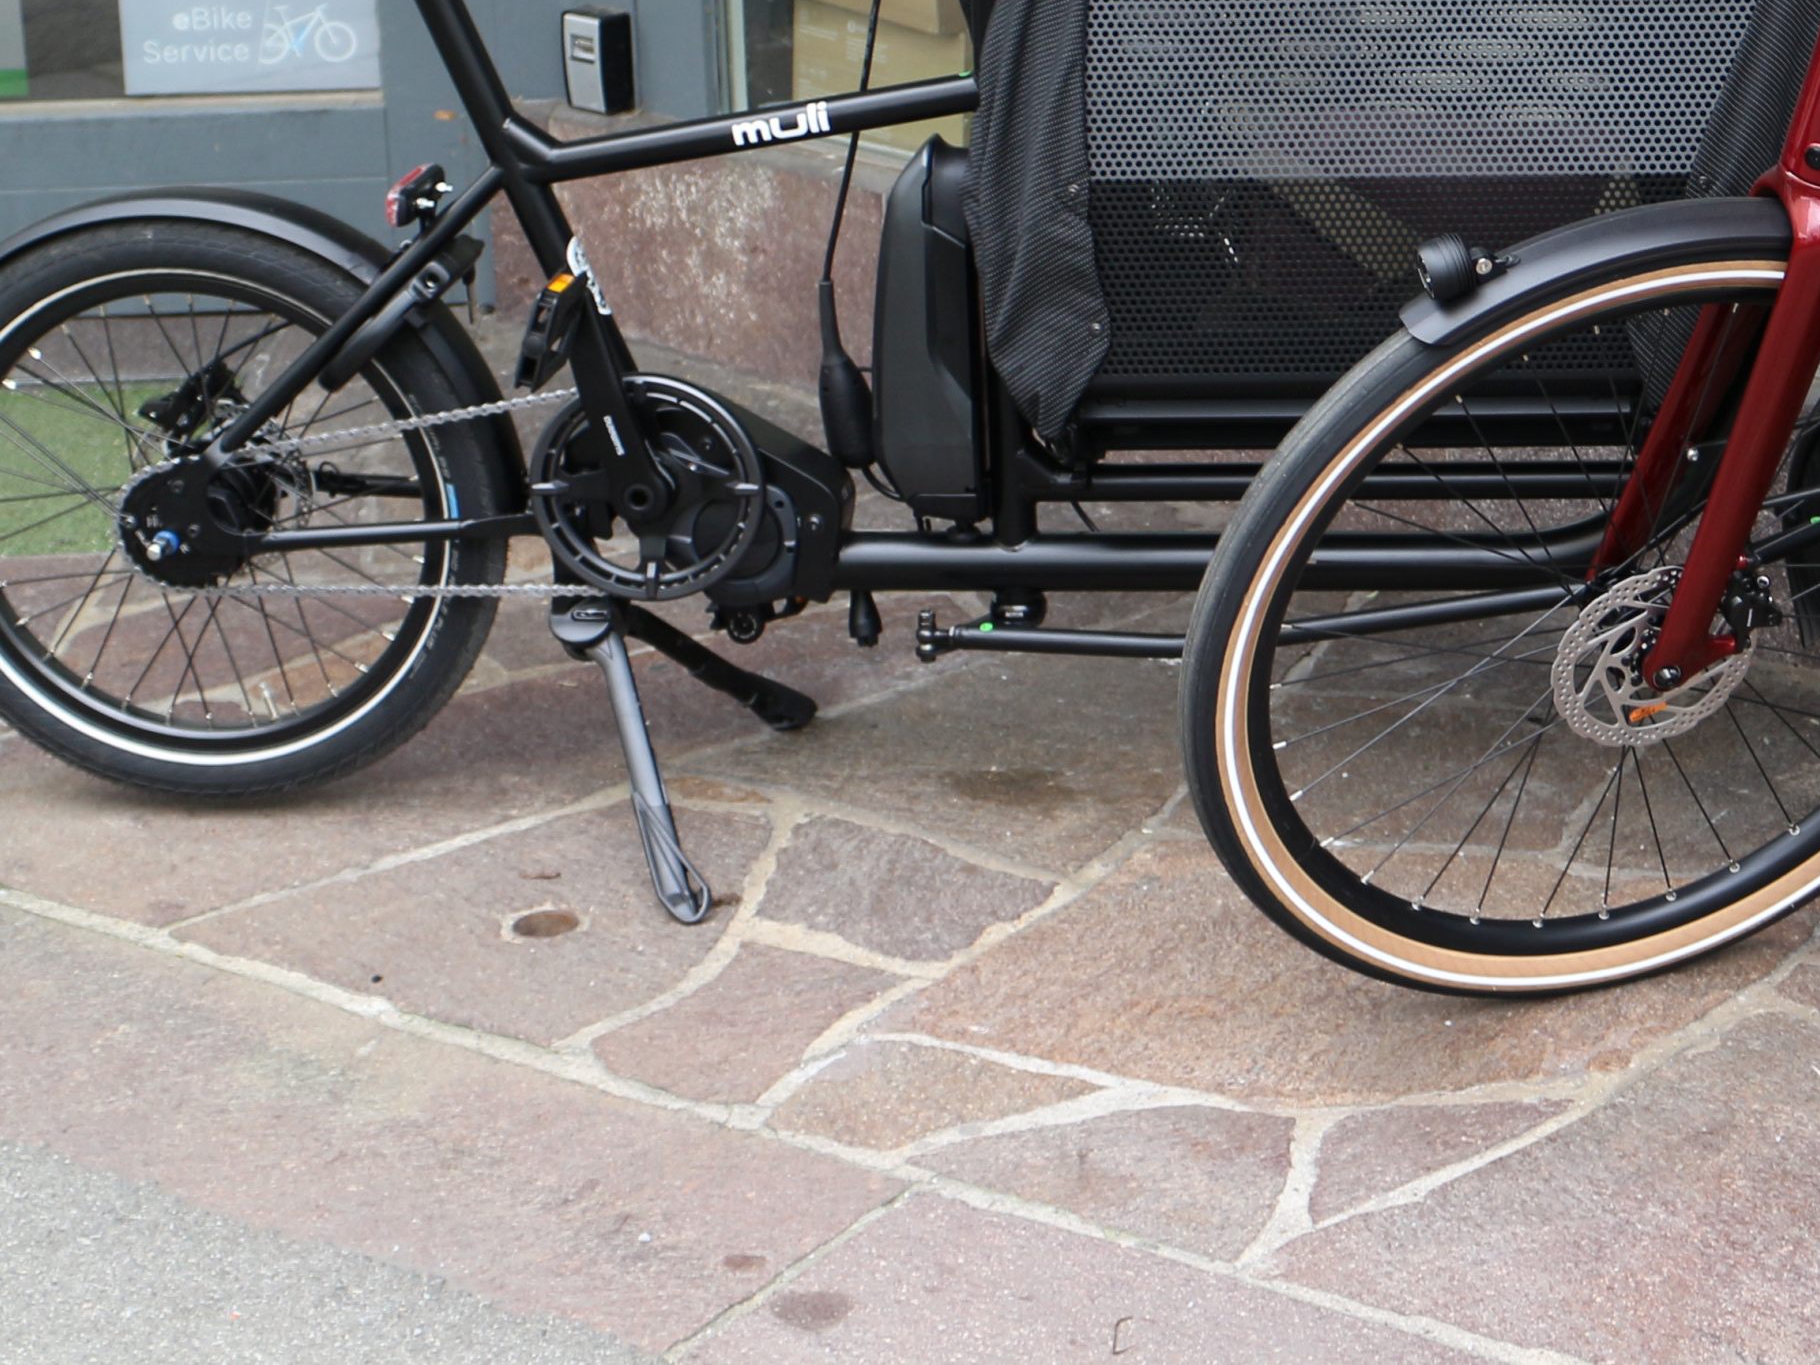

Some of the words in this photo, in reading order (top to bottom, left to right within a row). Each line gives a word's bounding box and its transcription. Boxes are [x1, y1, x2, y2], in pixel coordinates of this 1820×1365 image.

[172, 5, 252, 30] eBike
[143, 39, 249, 64] Service
[731, 101, 831, 146] muli
